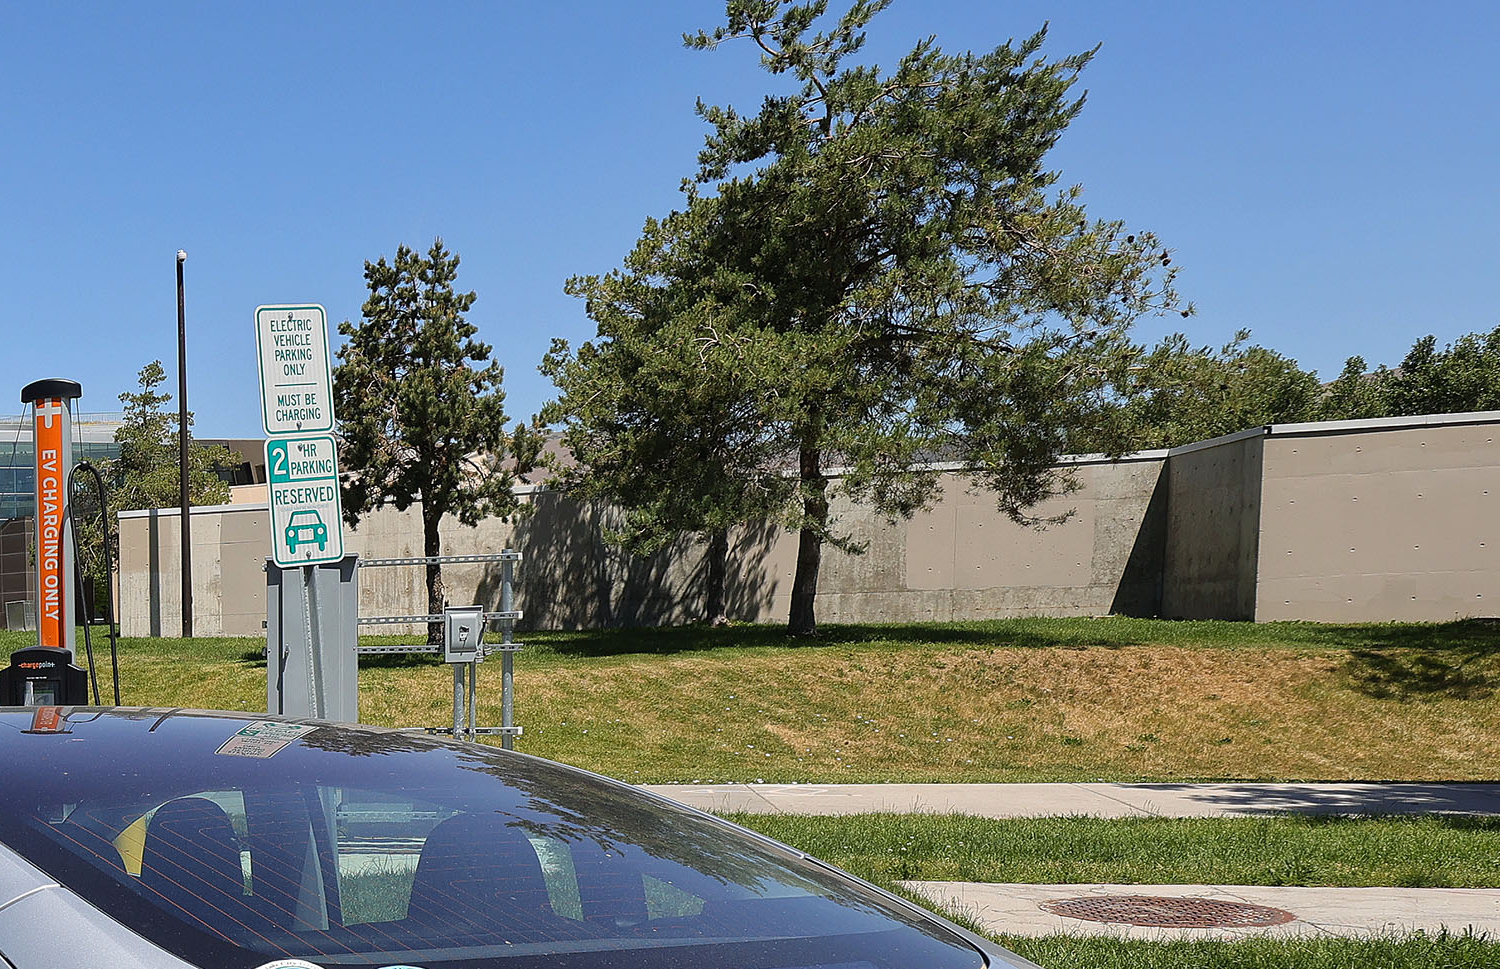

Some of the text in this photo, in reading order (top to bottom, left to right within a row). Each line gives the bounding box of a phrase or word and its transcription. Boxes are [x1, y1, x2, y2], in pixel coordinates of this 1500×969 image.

[270, 319, 312, 332] ELECTRIC
[274, 334, 311, 347] VEHICLE
[274, 348, 312, 362] PARKING
[283, 363, 306, 376] ONLY
[277, 392, 317, 407] MUST BE
[275, 407, 321, 422] CHARGING
[271, 443, 317, 476] 2 HR
[290, 459, 332, 475] PARKING
[274, 486, 334, 506] RESERVED
[42, 449, 60, 621] EV CHARGING ONLY
